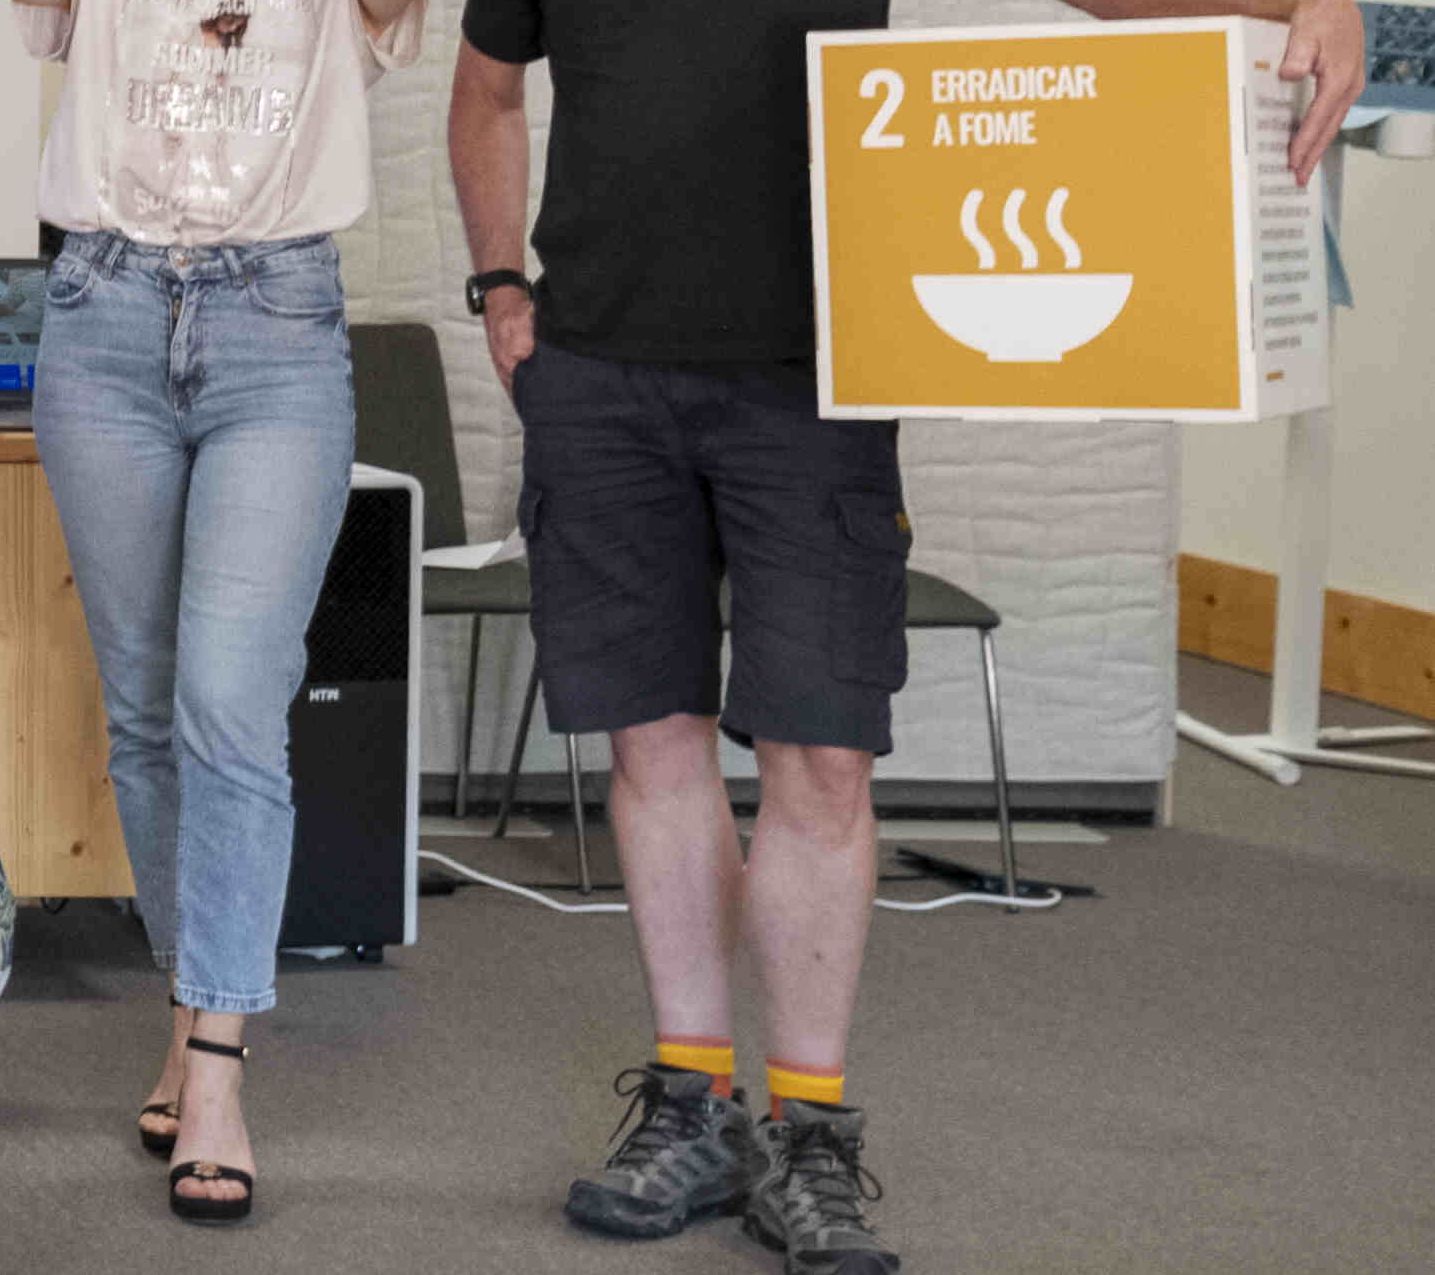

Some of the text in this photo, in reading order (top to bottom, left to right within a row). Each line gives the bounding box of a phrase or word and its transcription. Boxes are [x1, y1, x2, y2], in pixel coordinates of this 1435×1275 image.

[931, 64, 1097, 103] ERRADICAR
[858, 68, 905, 149] 2
[932, 110, 1038, 147] A FOME
